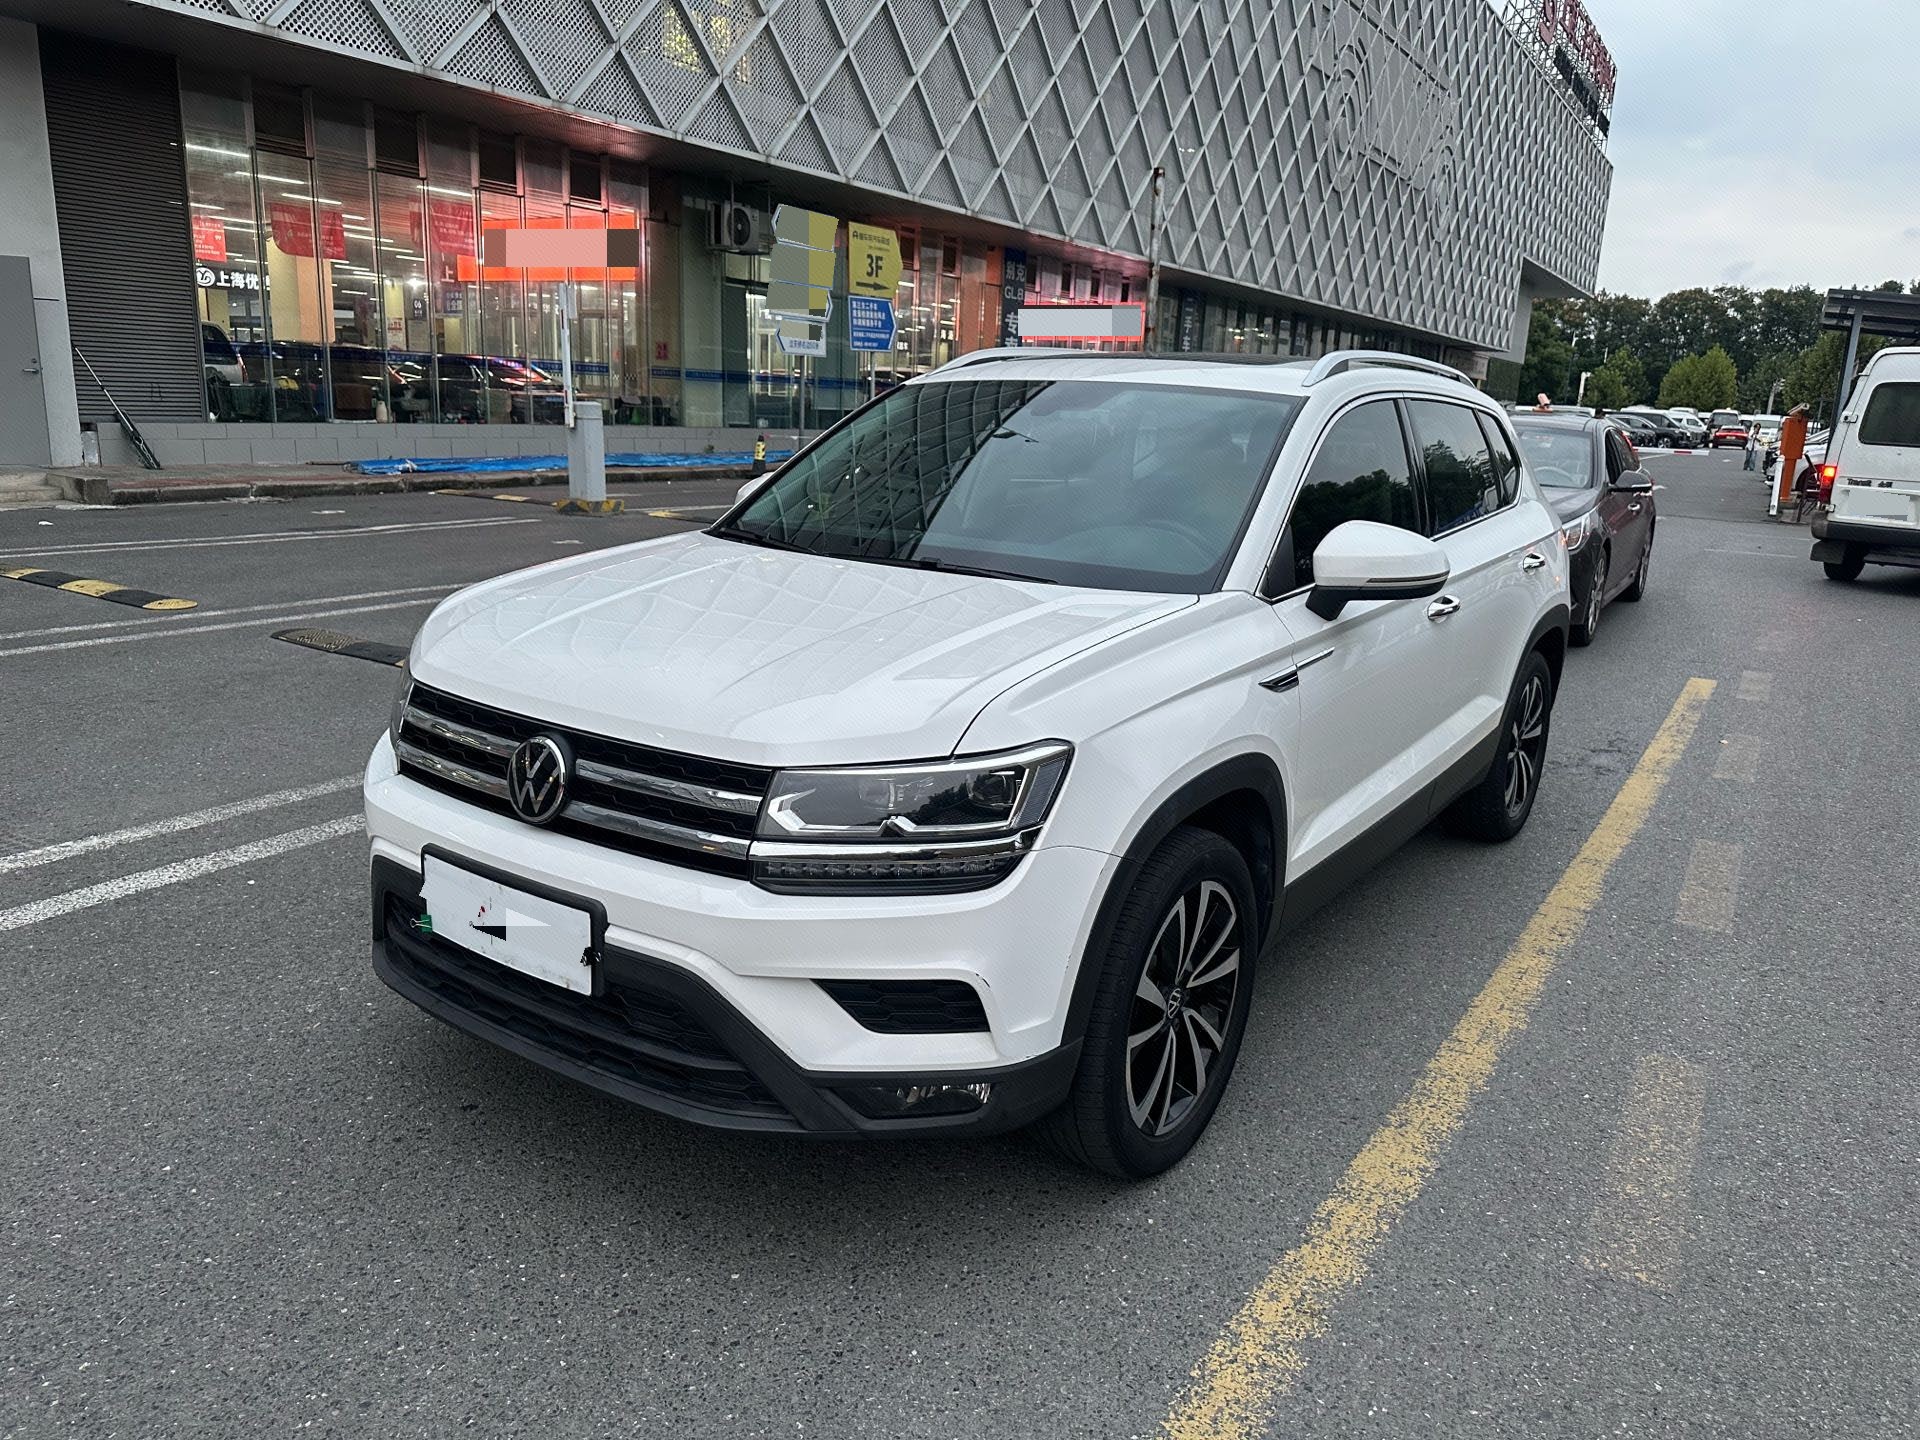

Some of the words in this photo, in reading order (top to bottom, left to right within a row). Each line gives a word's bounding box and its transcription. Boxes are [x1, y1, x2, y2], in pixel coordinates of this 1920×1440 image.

[866, 254, 883, 278] 3F
[216, 270, 270, 291] 上海优
[1004, 286, 1024, 300] GL8
